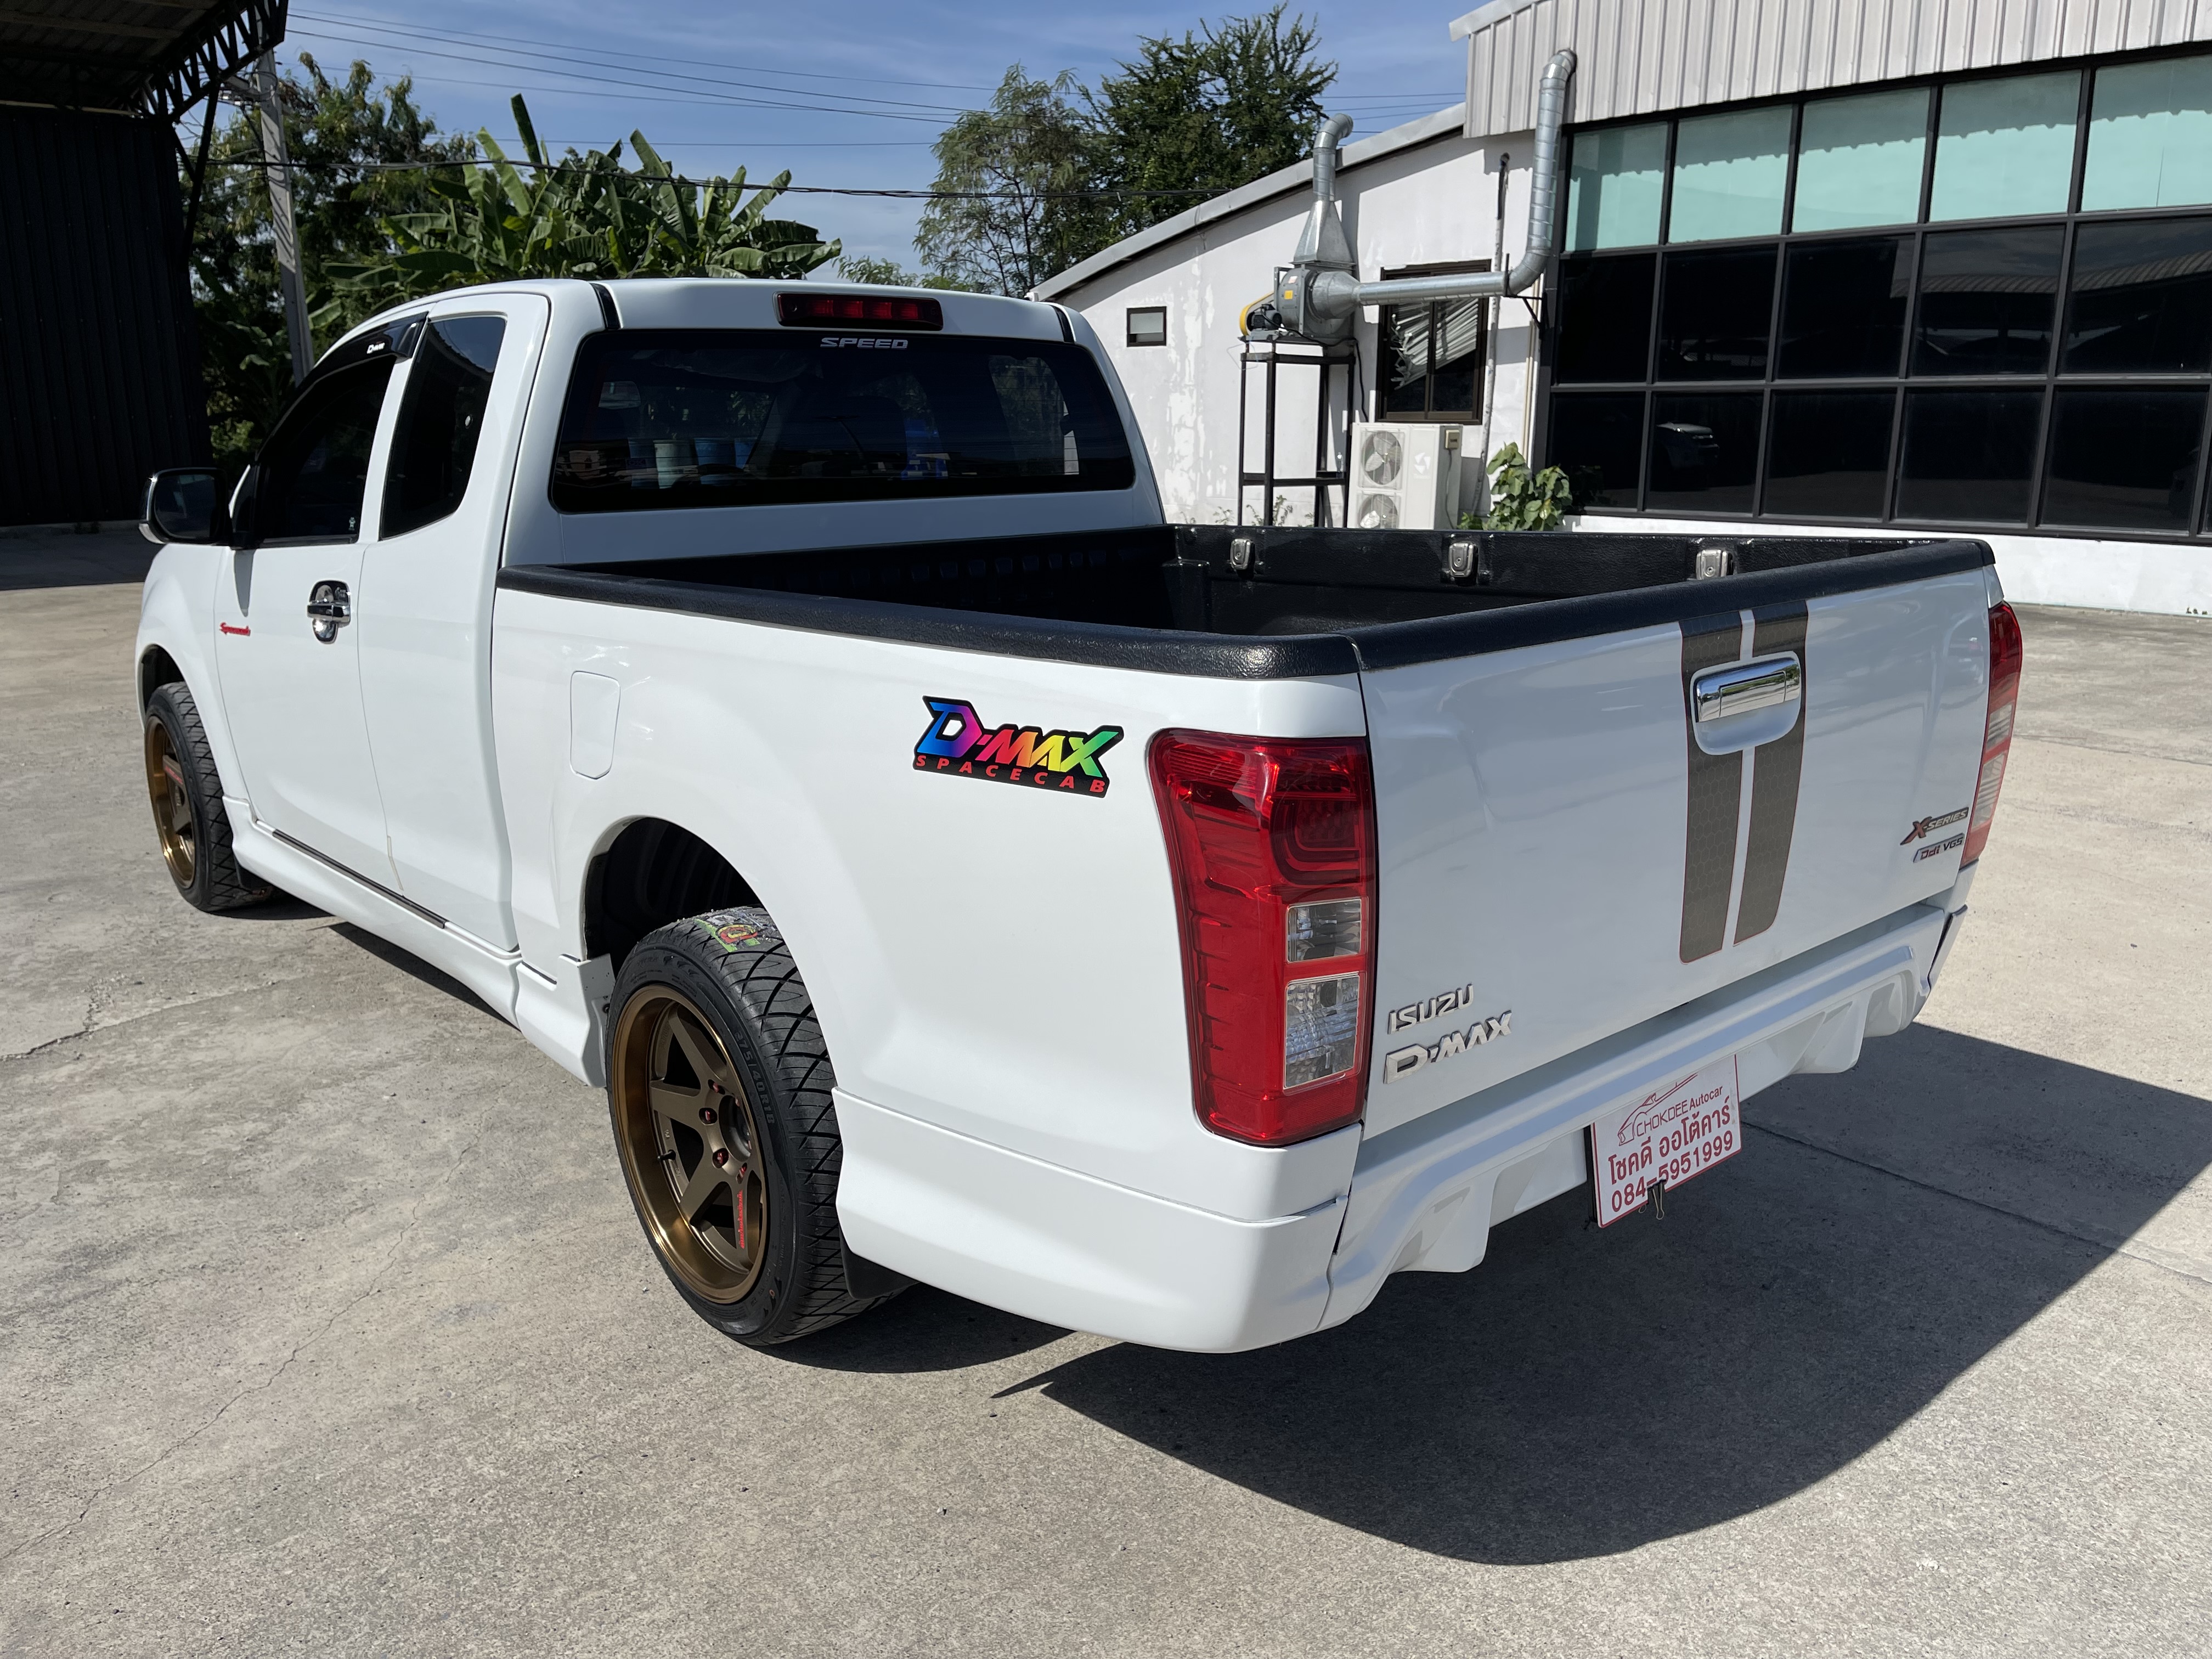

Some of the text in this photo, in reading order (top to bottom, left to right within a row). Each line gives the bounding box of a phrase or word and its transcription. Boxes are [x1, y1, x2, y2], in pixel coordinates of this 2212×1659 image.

[820, 337, 909, 350] SPEED
[916, 701, 1120, 778] D-MAX
[916, 755, 1105, 793] SPACECAB
[1900, 809, 1968, 845] X-SERIES
[1387, 983, 1474, 1035] ISUZU
[1383, 1009, 1513, 1084] D-MAX
[1636, 1085, 1723, 1137] CHOKDEE Autocar
[1659, 1095, 1731, 1158] ออโต้คาร์
[1611, 1130, 1733, 1212] 084-5951999
